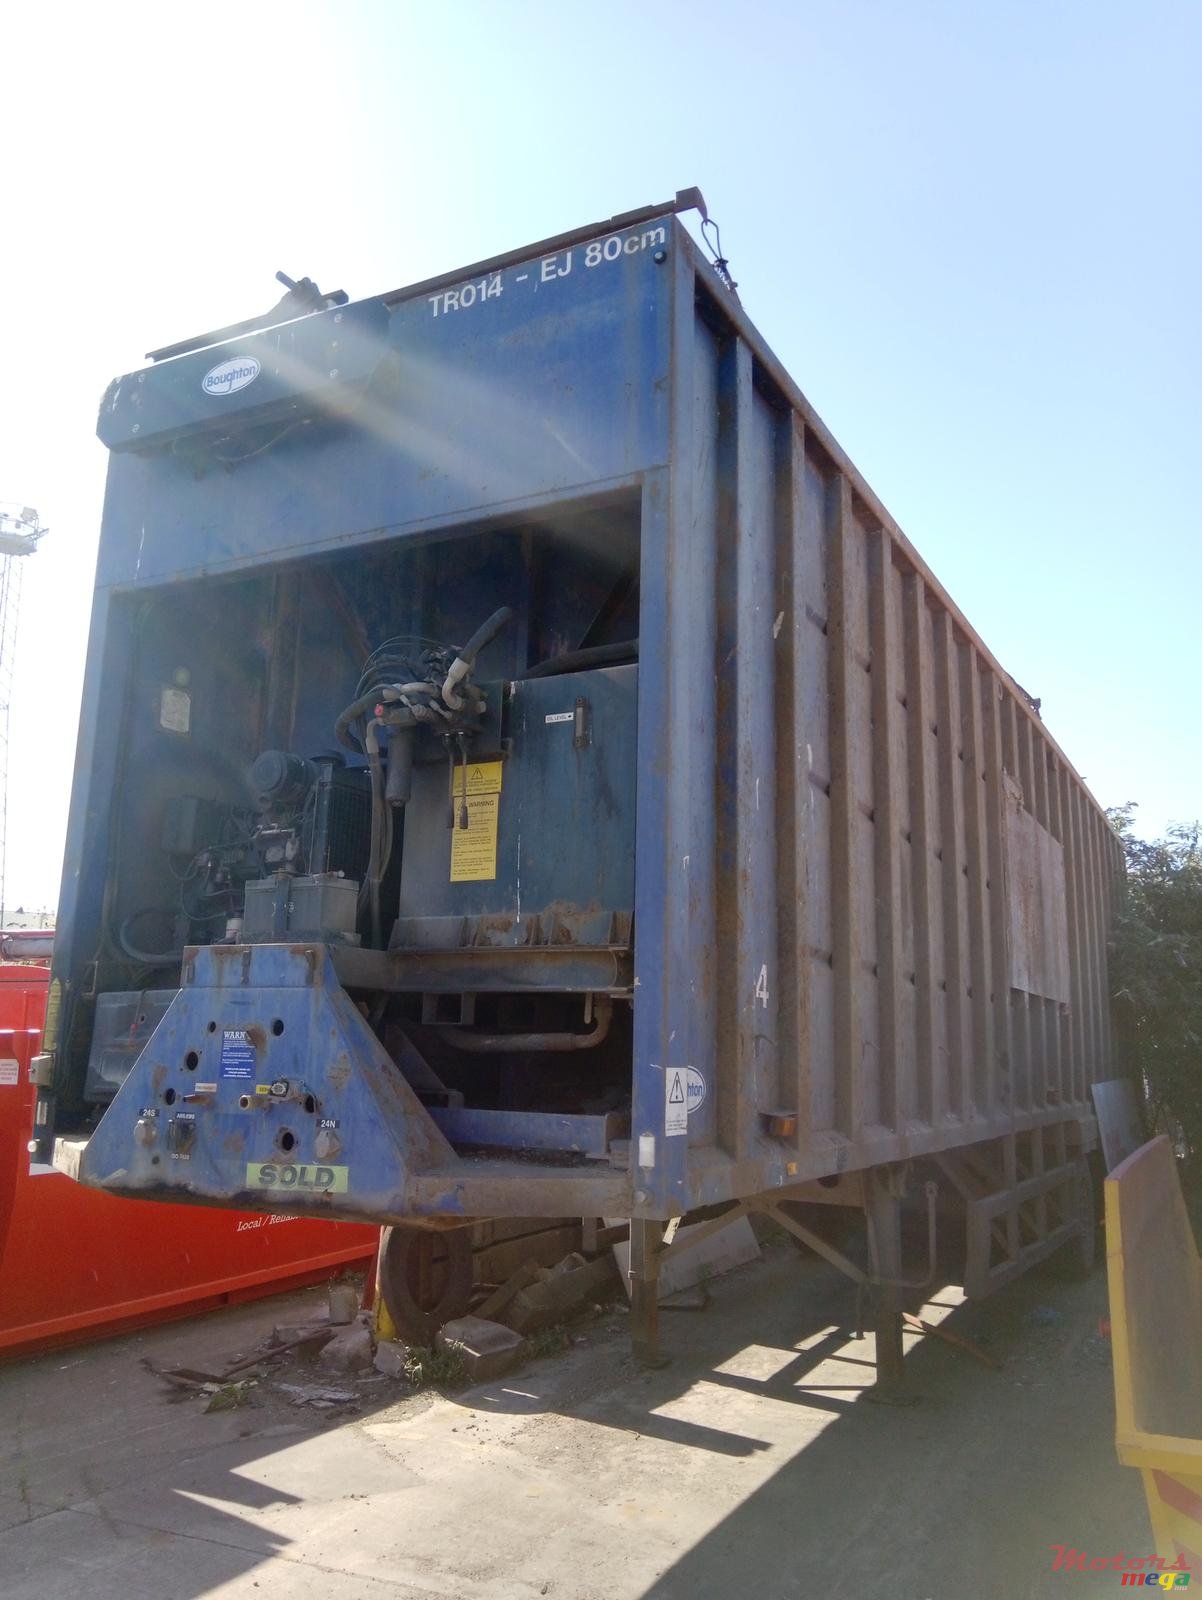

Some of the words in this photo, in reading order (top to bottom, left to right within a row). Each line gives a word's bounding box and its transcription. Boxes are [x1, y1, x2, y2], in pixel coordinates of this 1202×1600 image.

[541, 252, 572, 282] EJ
[585, 227, 665, 267] 80cm
[207, 366, 256, 390] Boughton
[756, 964, 769, 1008] 4
[321, 1119, 336, 1128] 24N
[258, 1165, 335, 1189] SOLD
[237, 1216, 262, 1231] Local
